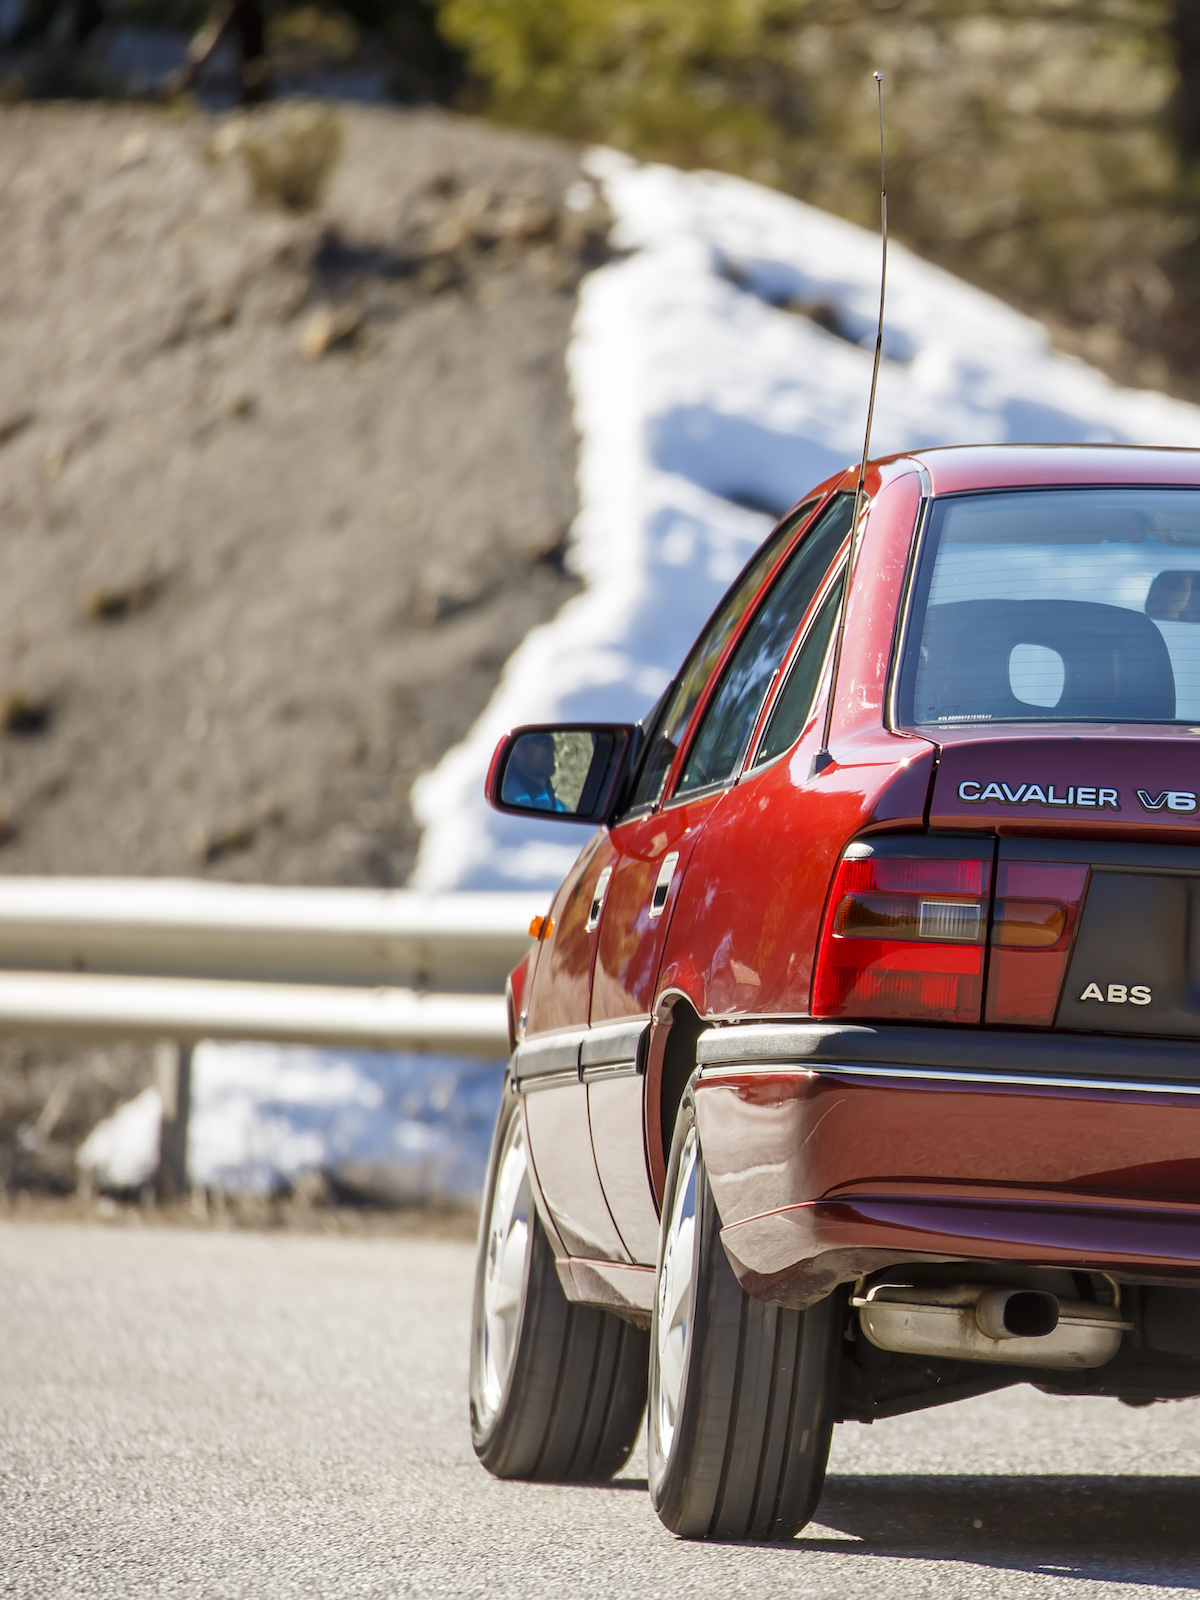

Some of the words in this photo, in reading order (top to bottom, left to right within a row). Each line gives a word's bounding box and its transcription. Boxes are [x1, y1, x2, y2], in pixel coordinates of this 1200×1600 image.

[958, 781, 1118, 807] CAVALIER
[1136, 789, 1197, 811] V6
[1080, 982, 1152, 1006] ABS
